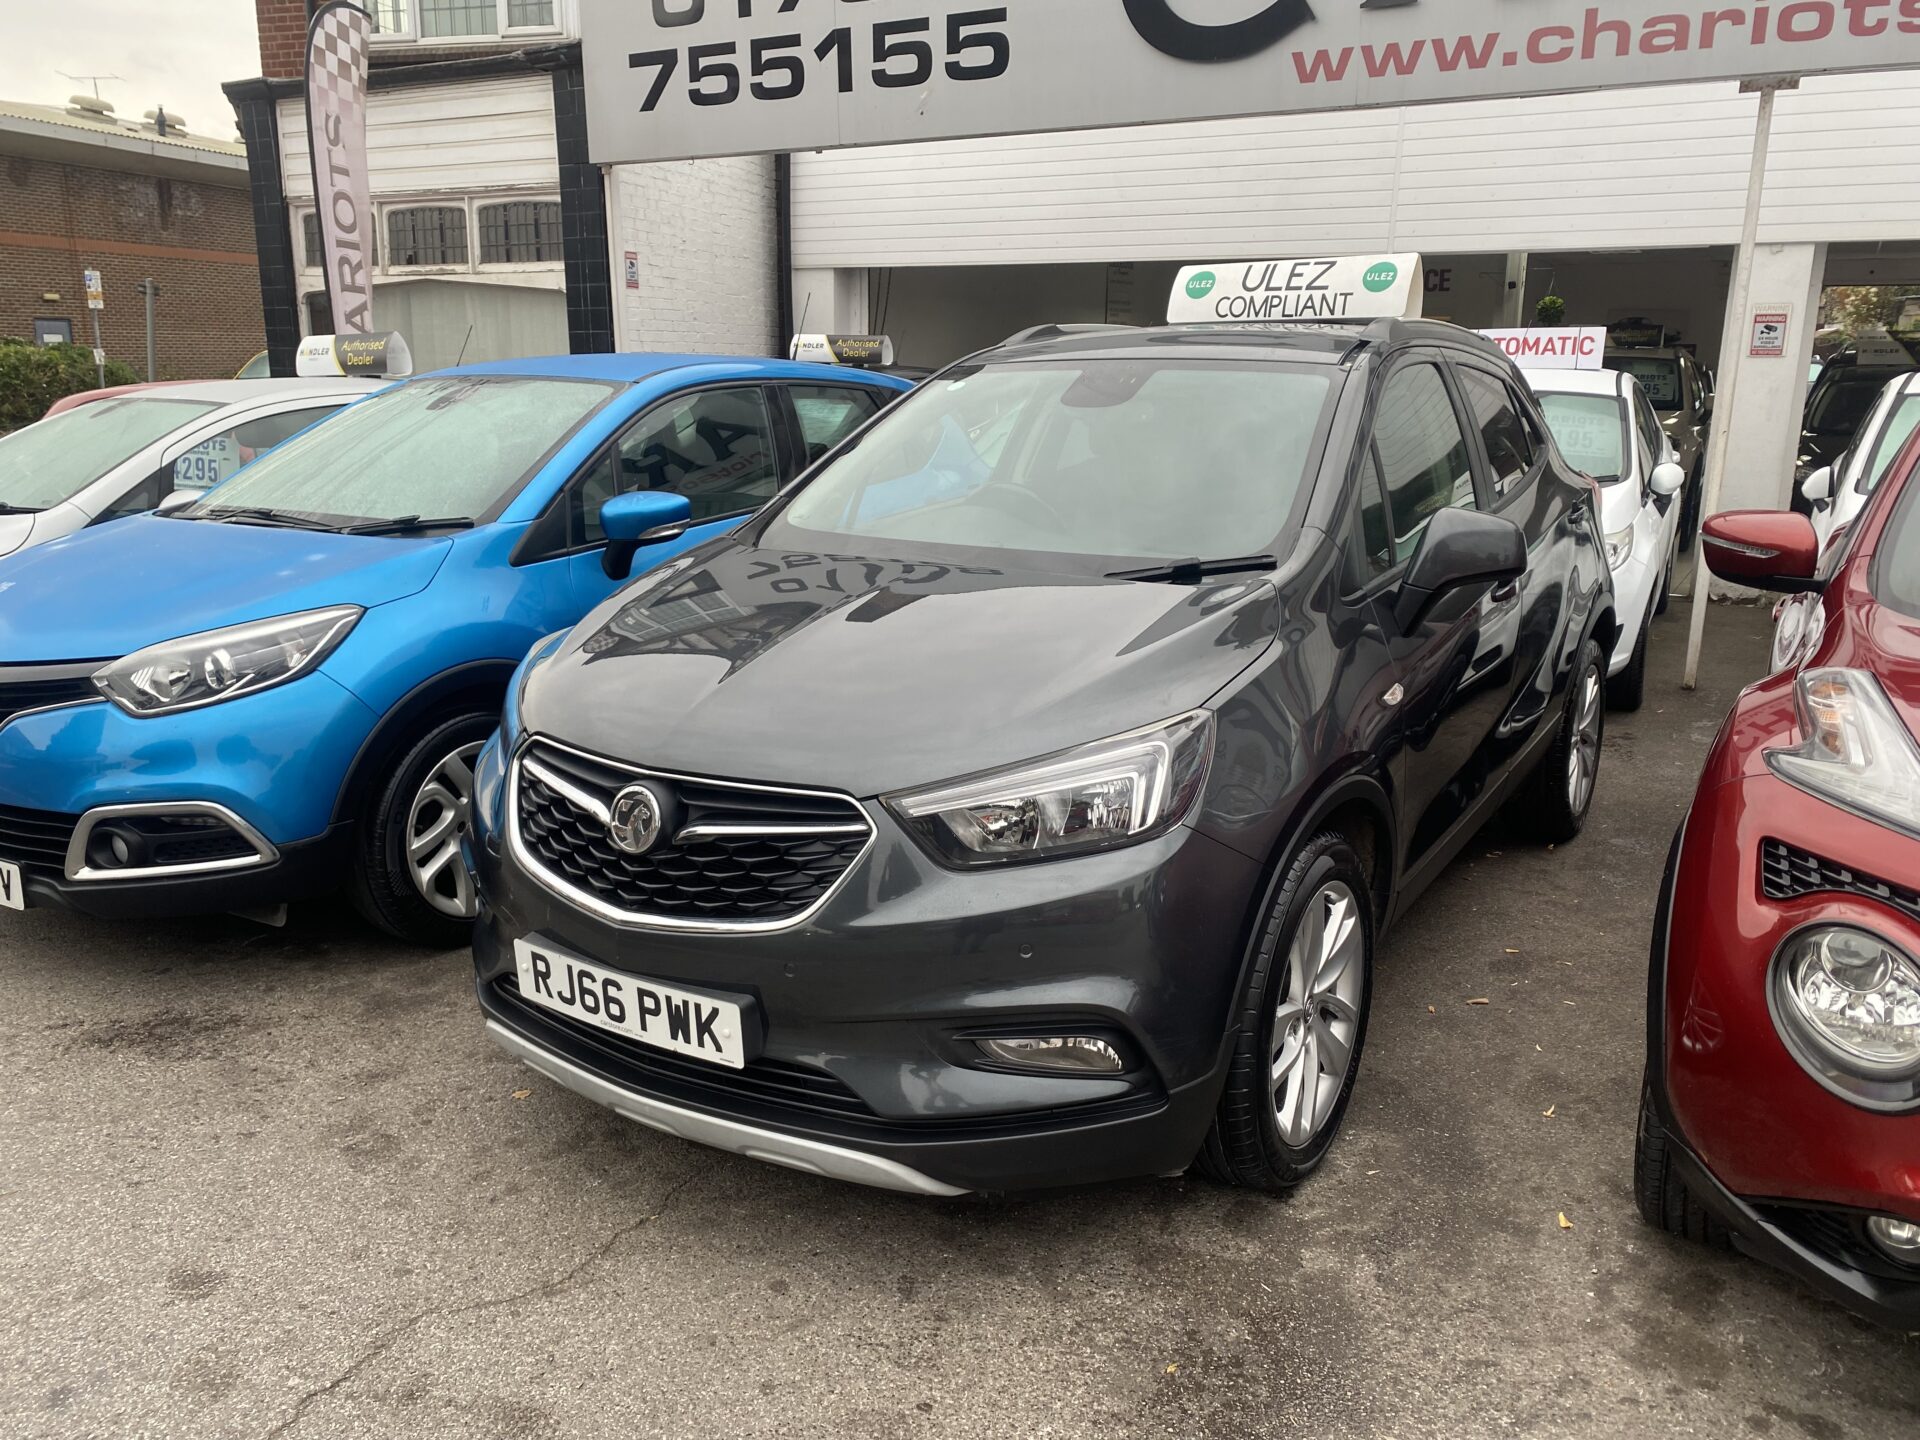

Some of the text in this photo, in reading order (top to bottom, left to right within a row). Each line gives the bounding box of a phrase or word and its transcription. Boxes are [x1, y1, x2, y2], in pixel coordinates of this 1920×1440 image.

[628, 7, 1010, 112] 755155
[1241, 261, 1338, 292] ULEZ
[1366, 271, 1395, 281] ULEZ
[1189, 279, 1213, 289] ULEZ
[1215, 293, 1354, 318] COMPLIANT
[341, 338, 387, 351] Authorised
[836, 338, 880, 348] Authorised
[347, 352, 375, 365] Dealer
[842, 348, 870, 357] Dealer
[530, 950, 724, 1053] RJ66 PWK
